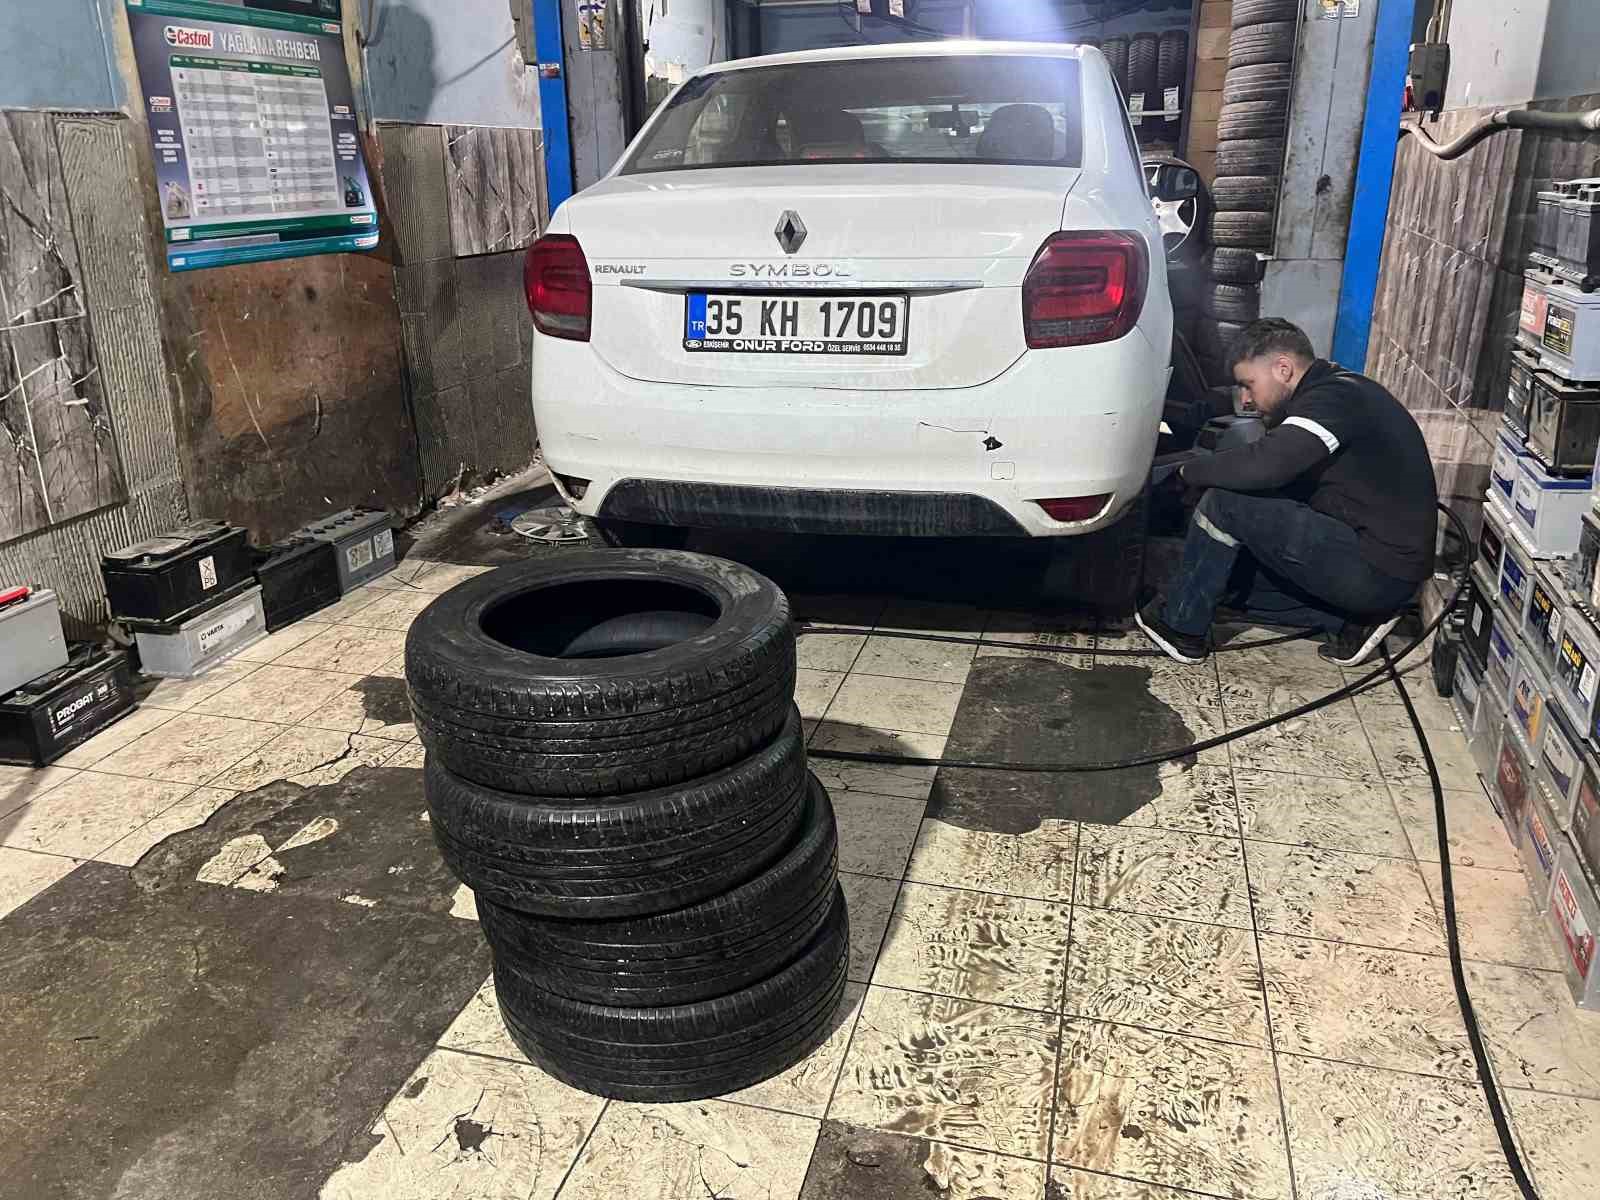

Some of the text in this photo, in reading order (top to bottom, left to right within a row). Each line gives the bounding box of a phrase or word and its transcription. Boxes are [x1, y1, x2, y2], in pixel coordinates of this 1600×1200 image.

[177, 29, 212, 47] Castrol
[219, 31, 321, 61] YAĞLAMA REHBERİ
[594, 264, 647, 274] RENAULT
[729, 263, 852, 277] SYMBOL
[706, 299, 897, 338] 35 KH 1709
[691, 321, 705, 331] TR
[733, 340, 777, 351] ONUR
[781, 340, 825, 352] FORD
[827, 343, 842, 352] ÖZEL
[204, 576, 216, 587] Pb
[206, 623, 224, 637] VARTA
[56, 691, 95, 721] PROBAT
